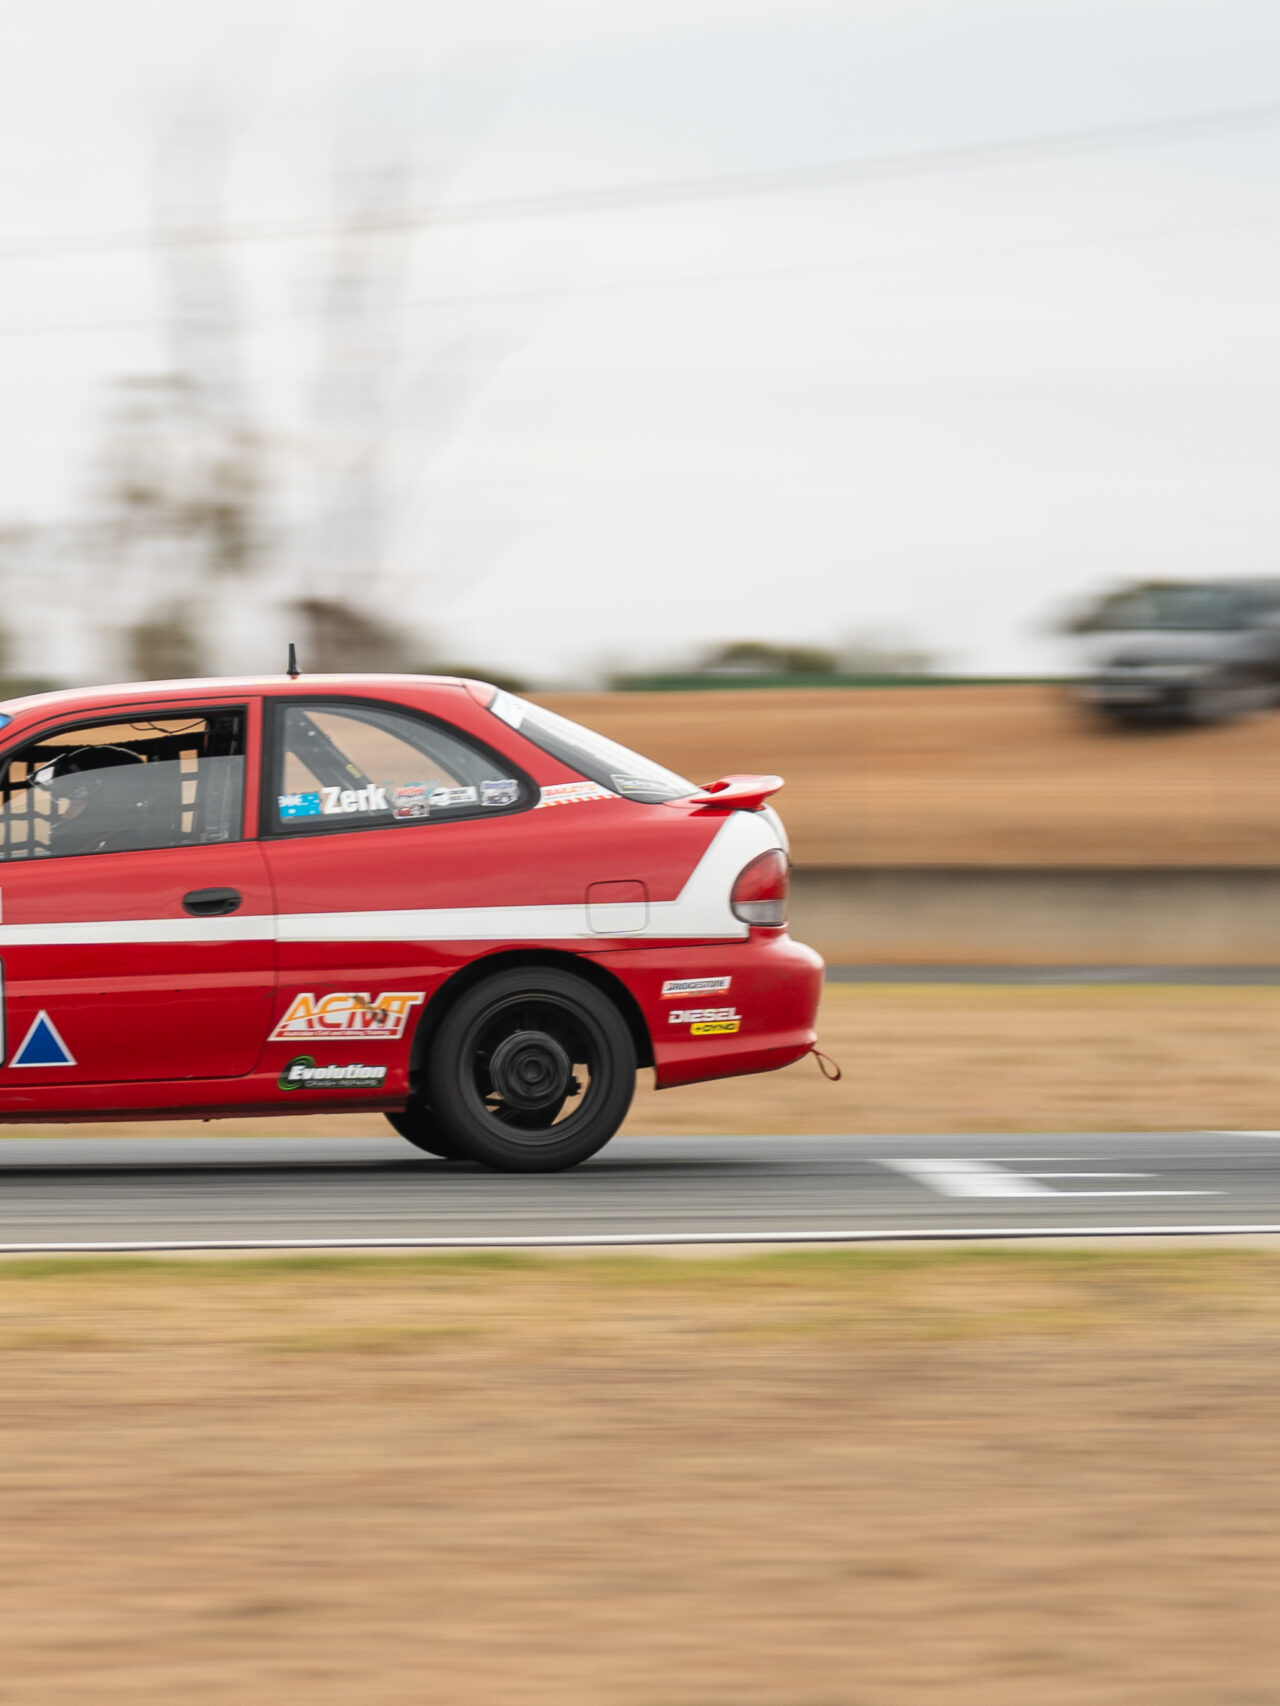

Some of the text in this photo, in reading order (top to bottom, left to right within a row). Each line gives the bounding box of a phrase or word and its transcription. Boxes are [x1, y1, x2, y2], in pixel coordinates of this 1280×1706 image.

[321, 783, 389, 815] Zerk
[276, 992, 426, 1030] ACMT
[668, 1007, 742, 1024] DIESEL
[287, 1064, 388, 1080] Evolution
